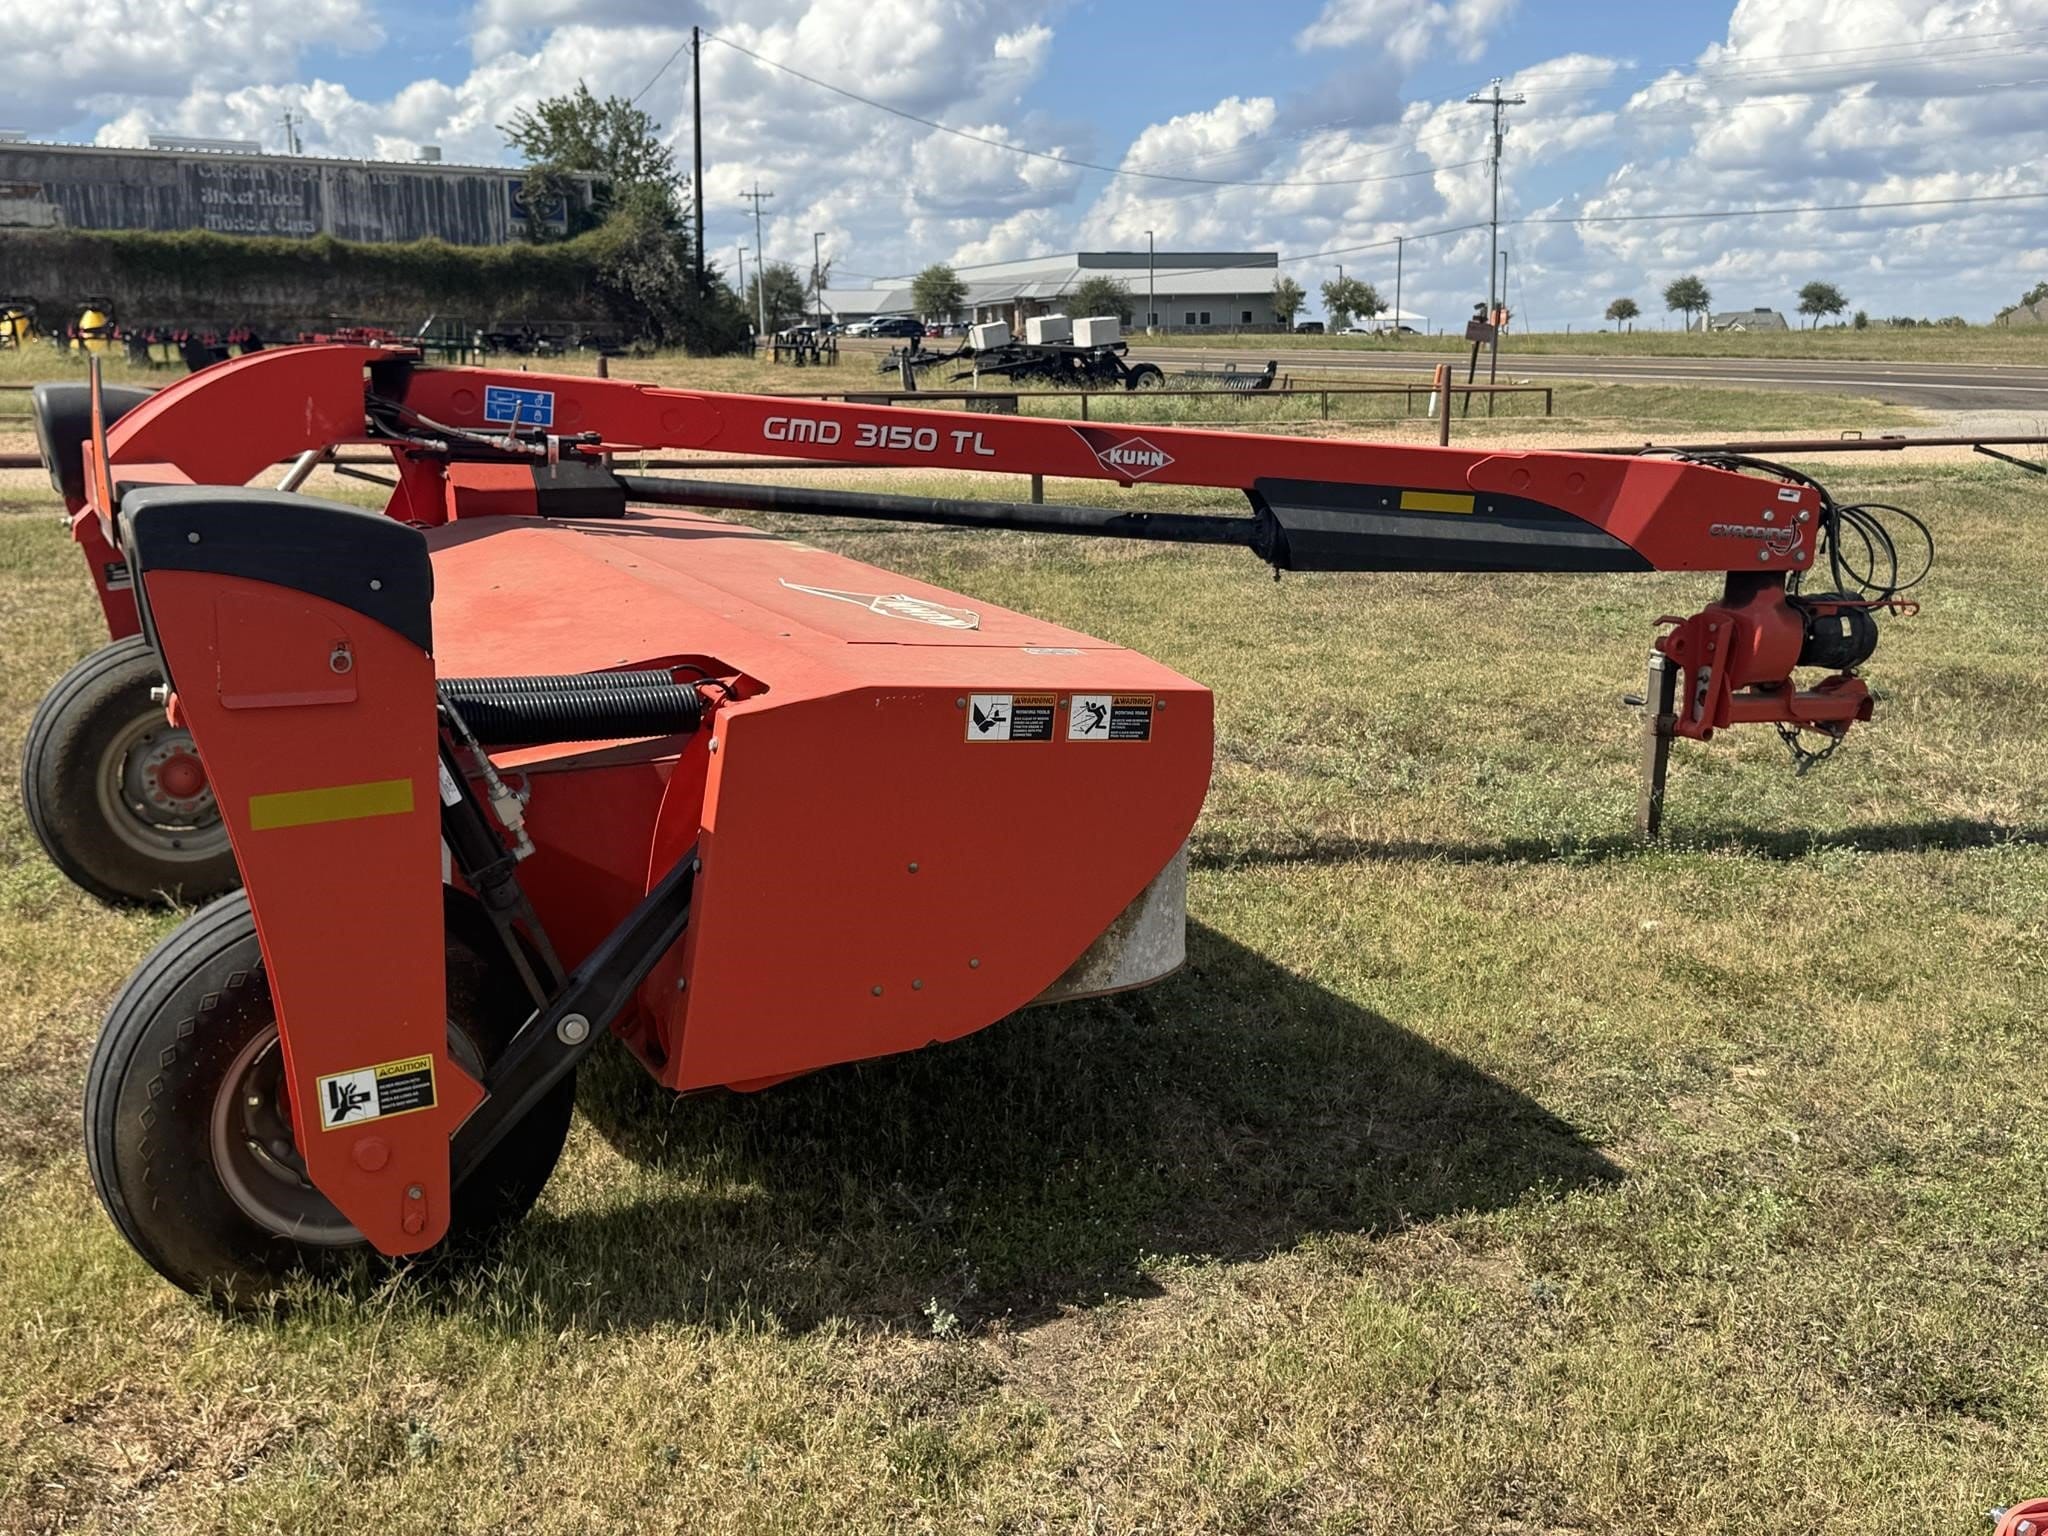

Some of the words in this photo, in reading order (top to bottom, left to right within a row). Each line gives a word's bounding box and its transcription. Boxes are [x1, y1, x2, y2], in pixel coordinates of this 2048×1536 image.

[763, 416, 841, 444] GMD
[854, 423, 938, 452] 3150
[950, 431, 995, 456] TL
[1109, 448, 1165, 467] KUHN
[1710, 523, 1792, 541] GYRODINE
[1020, 697, 1054, 706] WARNING
[1119, 697, 1151, 706] WARNING
[388, 1060, 427, 1074] CAUTION
